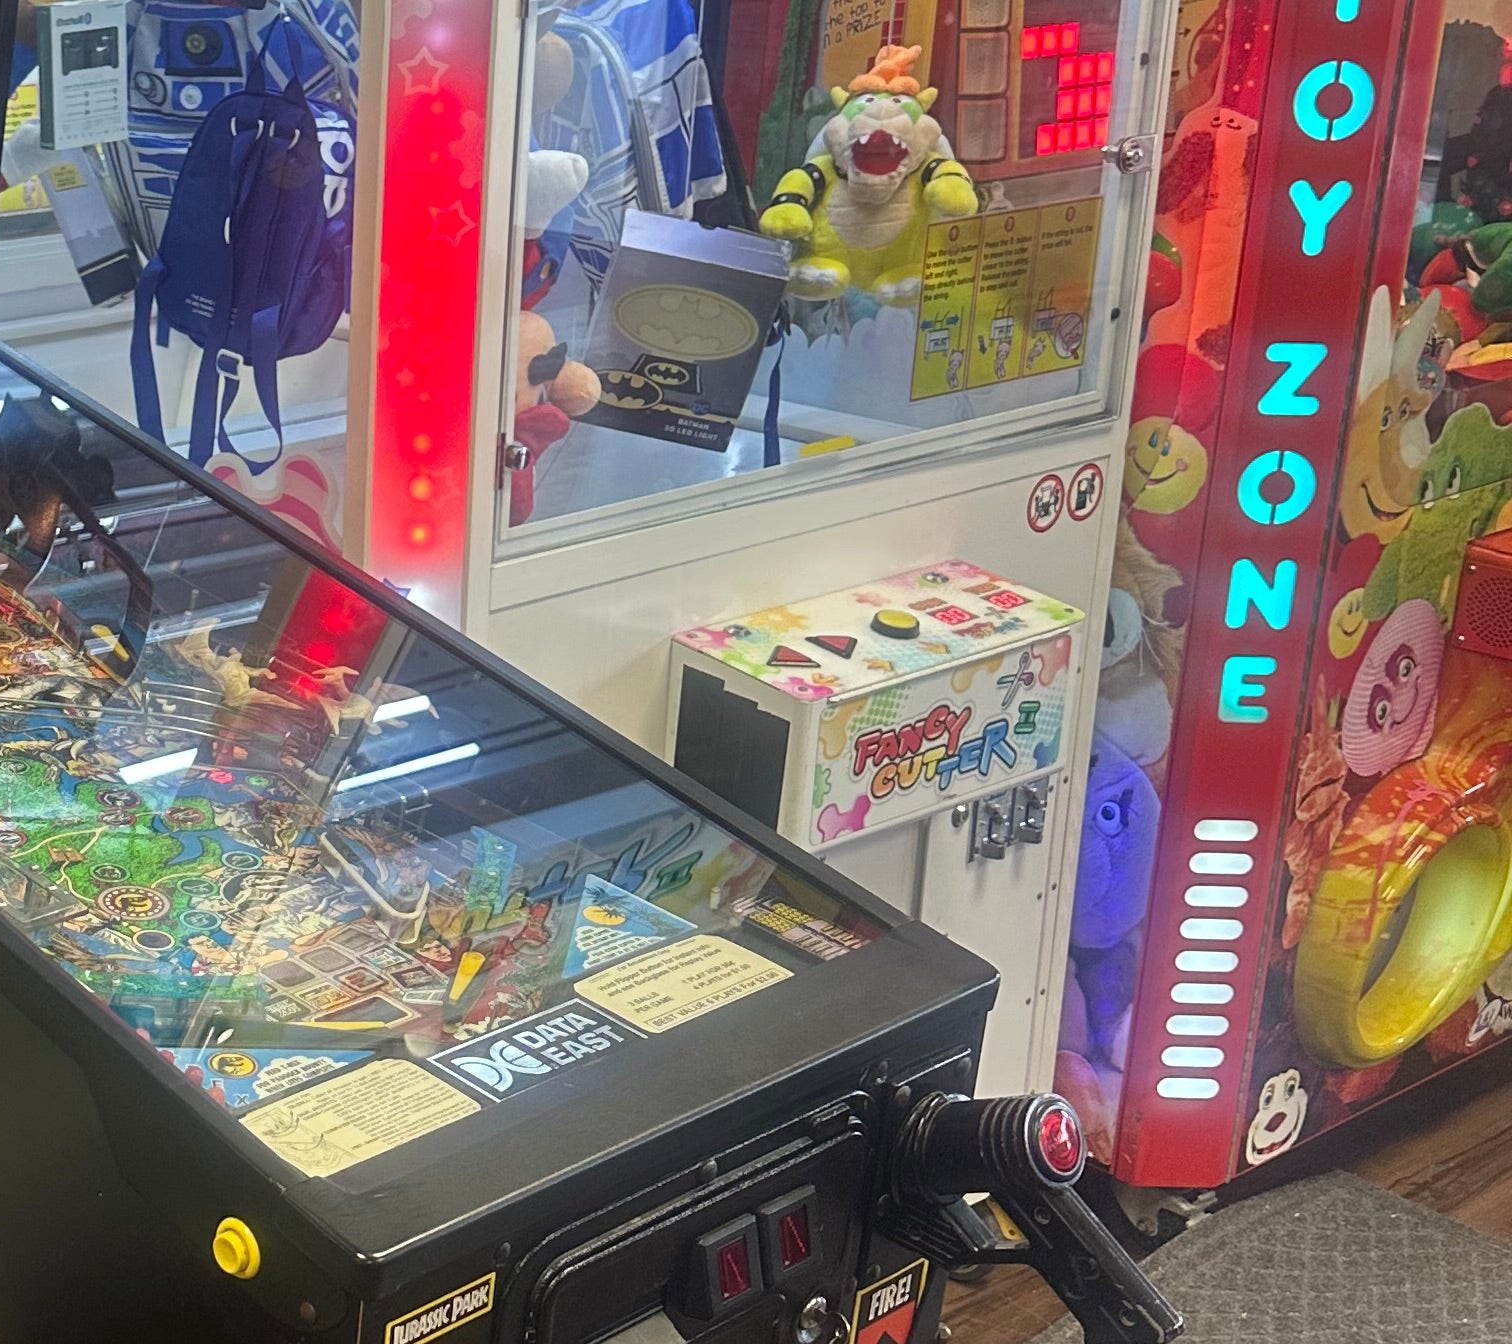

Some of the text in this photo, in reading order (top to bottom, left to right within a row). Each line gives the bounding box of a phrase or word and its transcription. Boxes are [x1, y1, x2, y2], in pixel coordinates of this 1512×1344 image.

[676, 425, 693, 435] LED
[693, 429, 719, 441] LIGHT
[677, 418, 710, 431] BATMAN
[1217, 341, 1329, 723] ZONE
[853, 704, 973, 776] FANCY
[871, 718, 1018, 798] CUTTER
[648, 995, 676, 1009] GAME
[652, 1012, 679, 1028] BEST
[679, 999, 708, 1017] VALUE
[713, 987, 742, 1003] PLAYS
[511, 1011, 599, 1050] DATA
[539, 1024, 625, 1067] EAST
[450, 1284, 489, 1323] PARK
[868, 1273, 914, 1321] FIRE!
